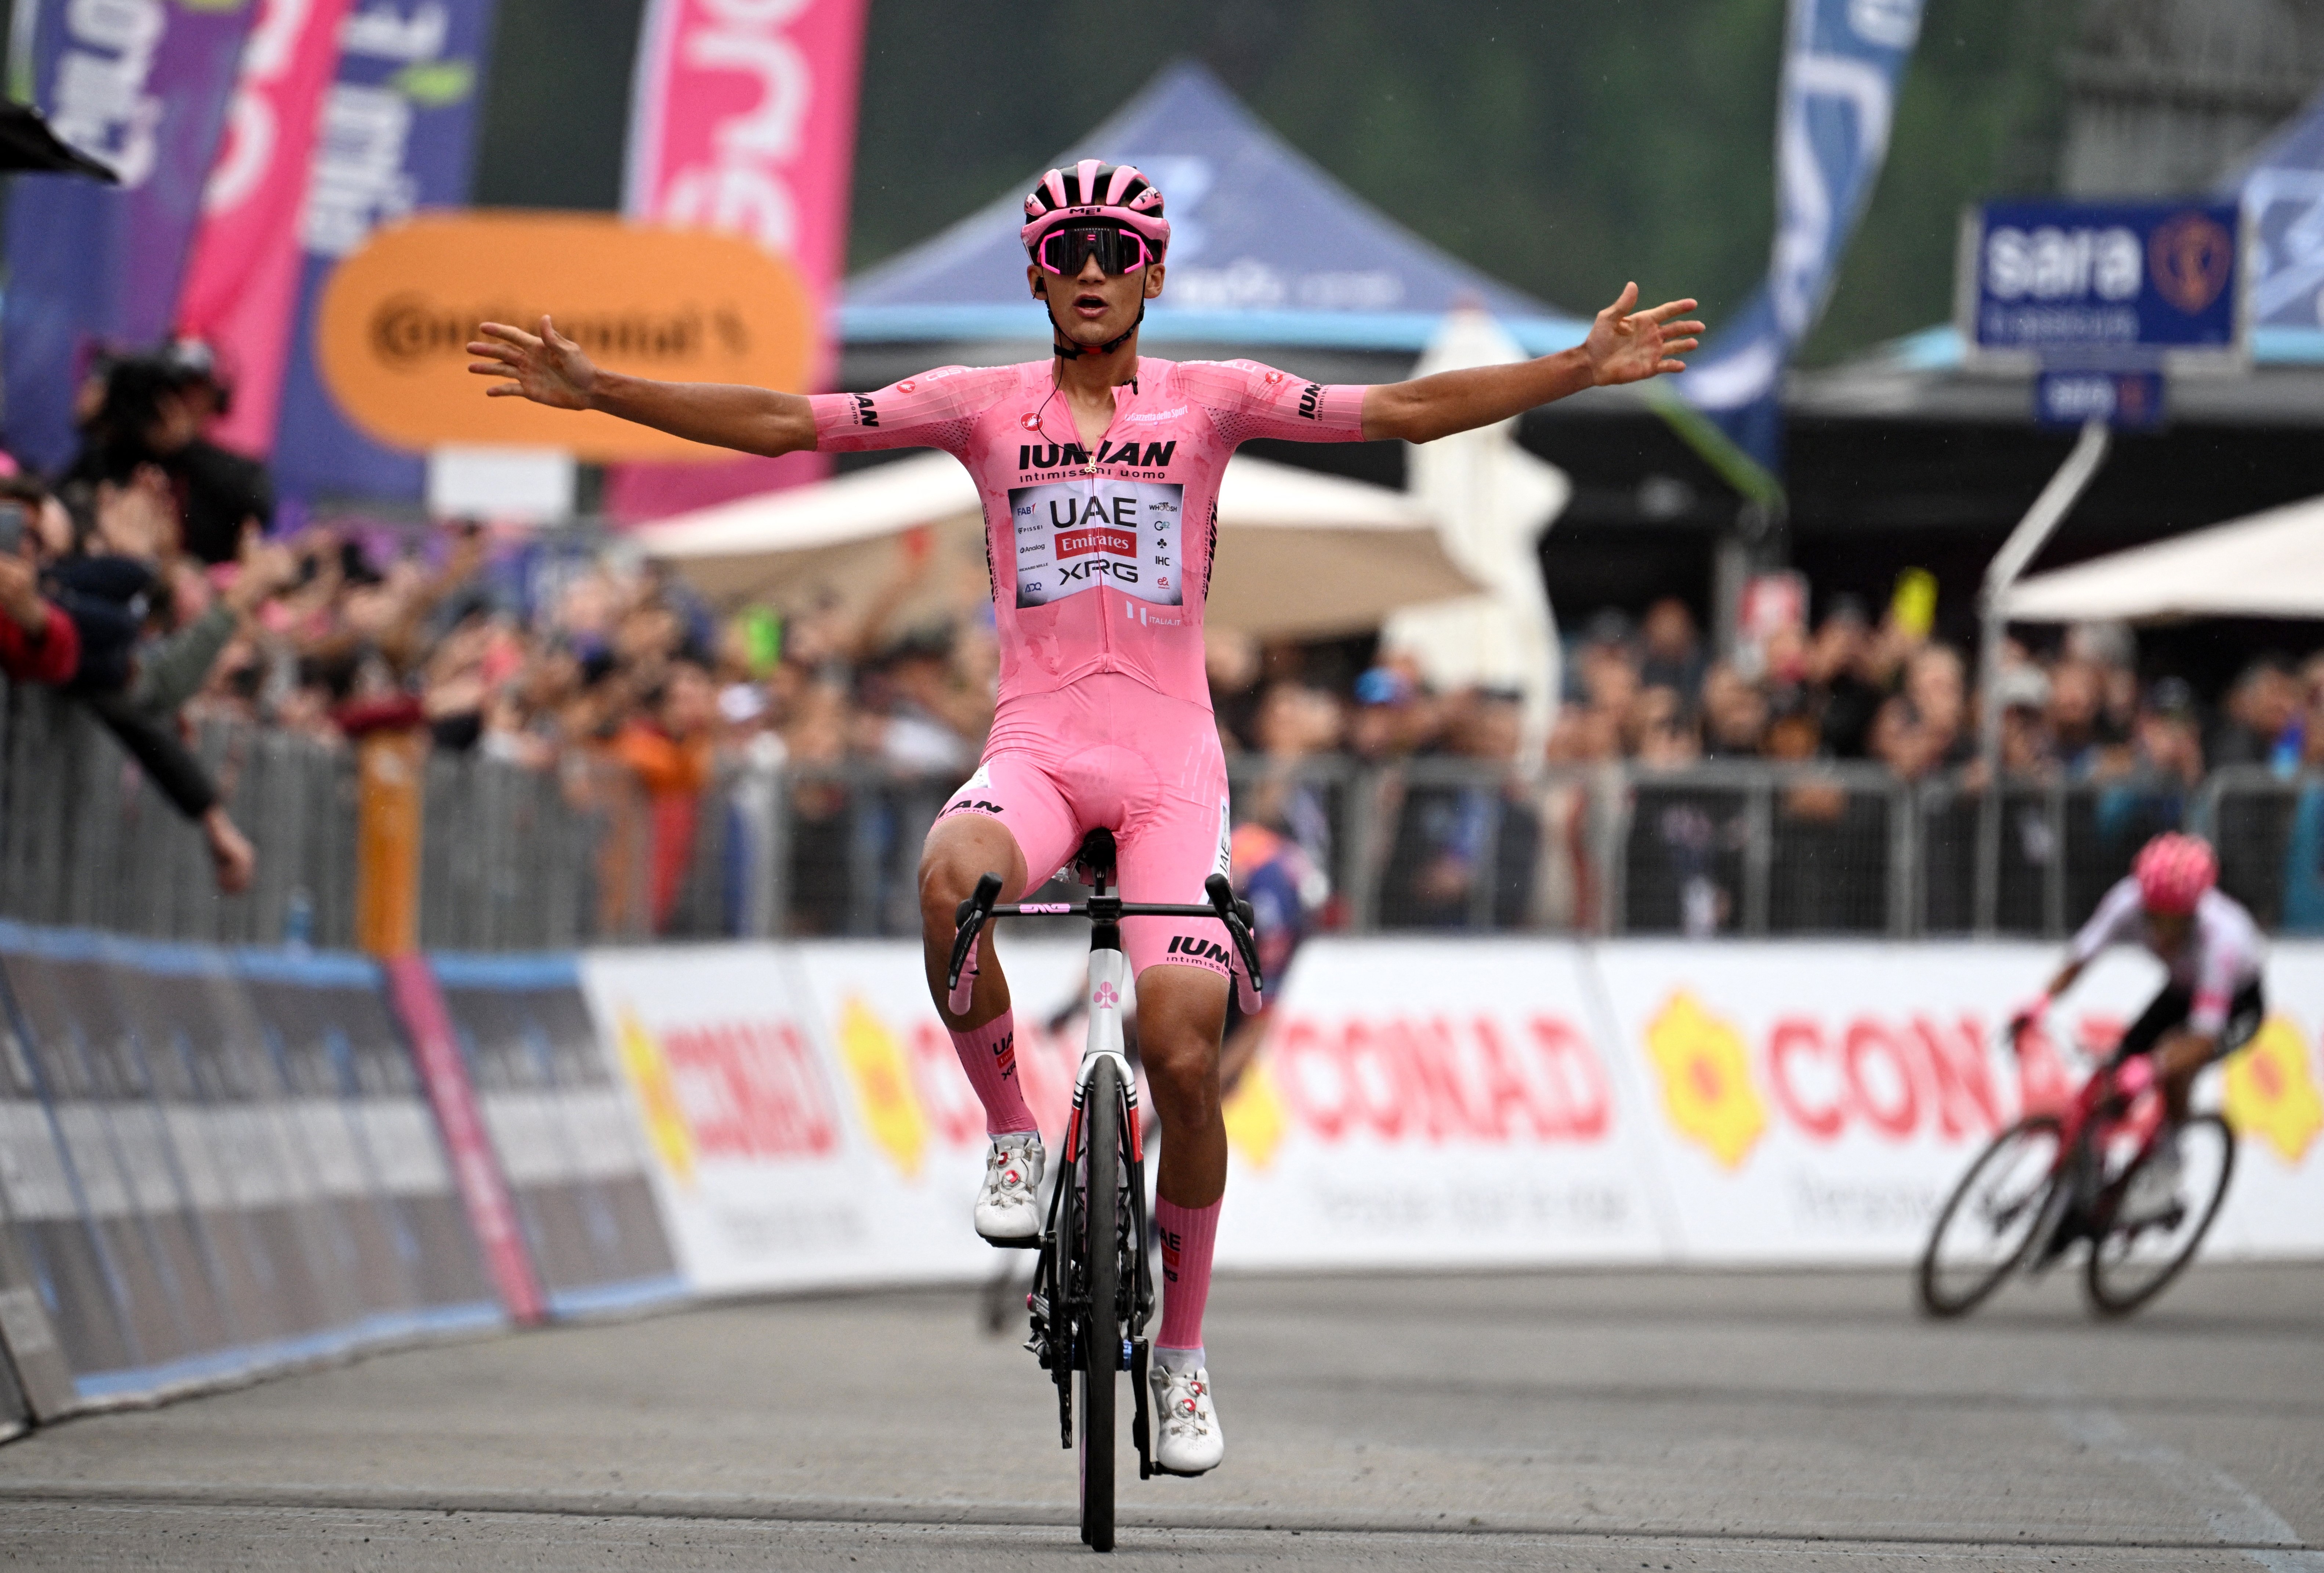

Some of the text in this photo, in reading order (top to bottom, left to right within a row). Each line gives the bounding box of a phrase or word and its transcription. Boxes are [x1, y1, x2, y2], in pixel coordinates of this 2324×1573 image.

[1069, 207, 1104, 215] MET
[1987, 226, 2142, 300] sara
[1131, 413, 1156, 421] Gazzetta
[1157, 411, 1170, 420] dello
[1171, 405, 1188, 418] Sport
[1020, 467, 1165, 483] intimissmi uomo
[1050, 496, 1137, 528] UAE
[1154, 521, 1170, 531] G42
[1025, 544, 1045, 552] Analog
[1062, 534, 1129, 551] Emirates
[1155, 555, 1170, 566] IHC
[1058, 559, 1138, 586] XRG
[1150, 616, 1181, 626] ITALIA.IT
[1276, 1015, 1610, 1143] CONAD
